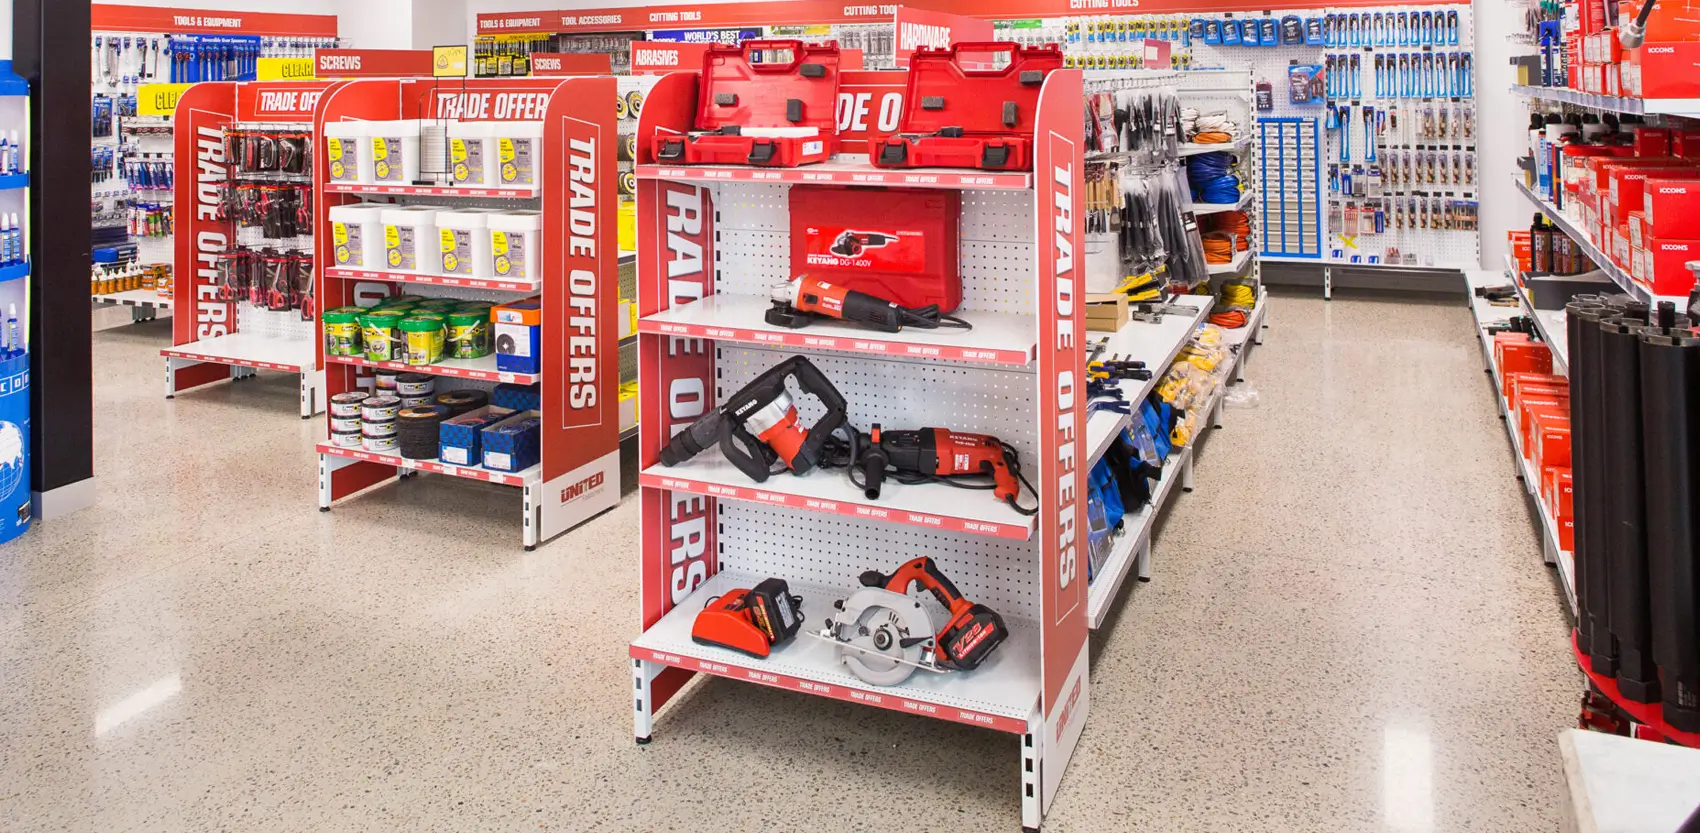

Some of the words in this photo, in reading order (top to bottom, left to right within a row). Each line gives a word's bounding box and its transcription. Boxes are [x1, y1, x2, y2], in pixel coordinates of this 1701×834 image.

[649, 12, 678, 22] CUTTING
[680, 12, 702, 20] TOOLS
[844, 6, 877, 16] CUTTING
[879, 5, 897, 14] TOO
[174, 16, 195, 26] TOOLS
[197, 17, 202, 26] &
[204, 17, 242, 28] EQUIPMENT
[480, 20, 498, 28] TOOLS
[506, 18, 541, 28] EQUIPMENT
[562, 16, 577, 25] TOOL
[579, 15, 622, 24] ACCESSORIES
[684, 32, 718, 40] WORLD'S
[720, 30, 740, 40] BEST
[901, 22, 950, 51] HARDWARE
[320, 56, 361, 70] SCREWS
[534, 58, 561, 70] SCREWS
[636, 50, 678, 66] ABRASIVES
[282, 64, 314, 77] CLEAR
[260, 92, 298, 111] TRADE
[437, 93, 490, 119] TRADE
[494, 93, 548, 119] OFFER
[197, 126, 227, 221] TRADE
[569, 137, 596, 258] TRADE
[1054, 160, 1074, 352] TRADE
[569, 269, 597, 410] OFFERS
[561, 471, 604, 503] UNITED
[1057, 370, 1076, 592] OFFERS
